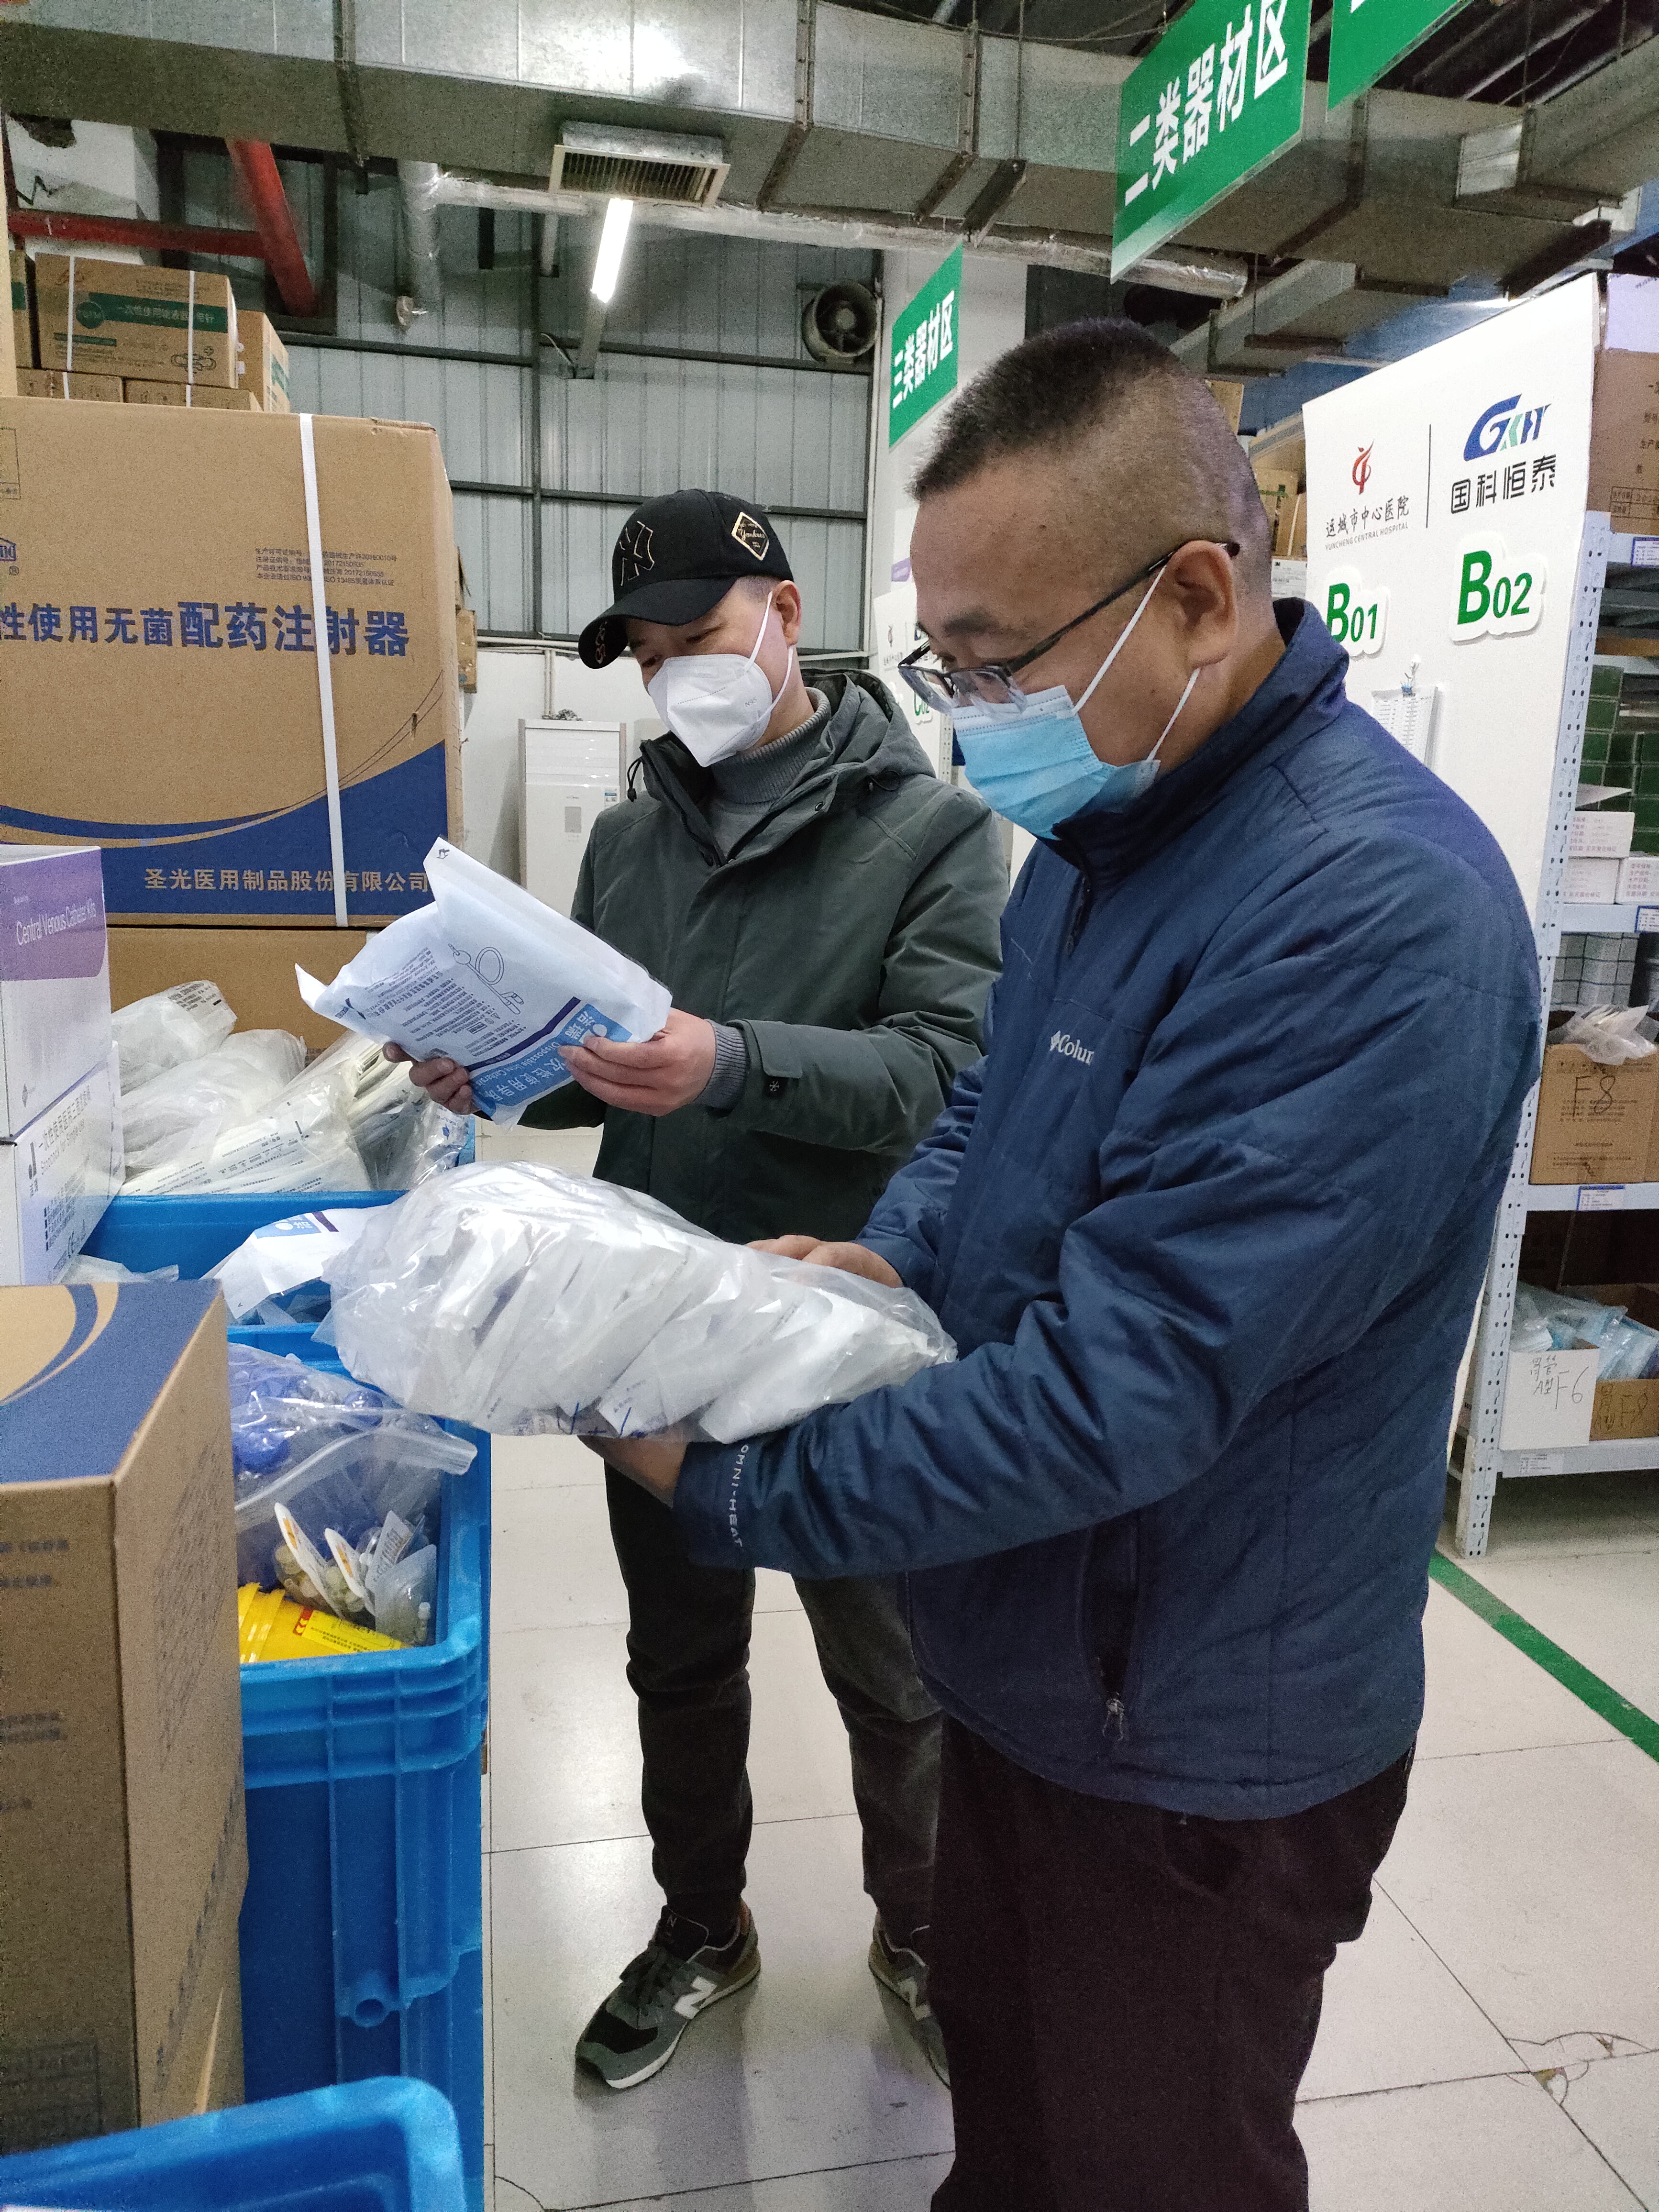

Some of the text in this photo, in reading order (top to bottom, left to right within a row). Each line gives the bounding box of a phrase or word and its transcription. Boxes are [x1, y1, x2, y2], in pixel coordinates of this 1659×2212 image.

[1125, 0, 1288, 207] 二类器材区
[893, 290, 955, 409] 三类器材区
[1451, 454, 1556, 514] 国科恒泰
[1325, 521, 1408, 551] YUNCHENG CENTRAL HOSPITAL
[1326, 495, 1409, 538] 运城市中心医院
[1457, 550, 1532, 625] B02
[1326, 582, 1378, 643] B01
[745, 697, 757, 707] N95
[144, 868, 429, 893] 圣光医用制品股份有限公司
[16, 913, 42, 945] Central
[42, 912, 66, 936] Venous
[564, 1010, 595, 1039] 洁瑞
[520, 1041, 561, 1066] Disposable
[1572, 1075, 1616, 1119] F8
